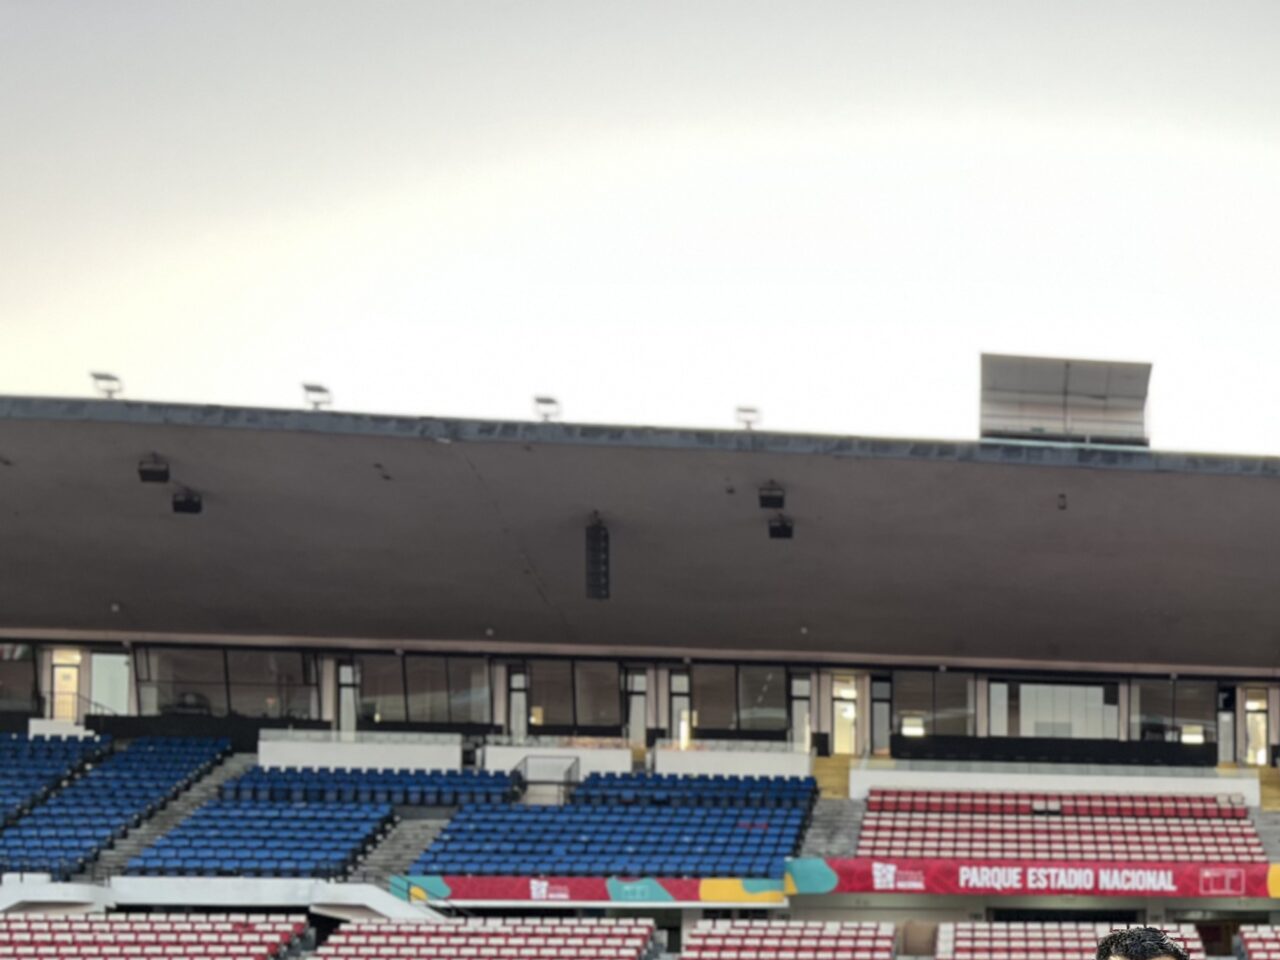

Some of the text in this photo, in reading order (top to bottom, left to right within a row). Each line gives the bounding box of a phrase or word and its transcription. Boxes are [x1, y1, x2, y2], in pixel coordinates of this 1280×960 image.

[959, 866, 1022, 890] PARQUE
[1027, 867, 1094, 889] ESTADIO
[1099, 869, 1177, 891] NACIONAL
